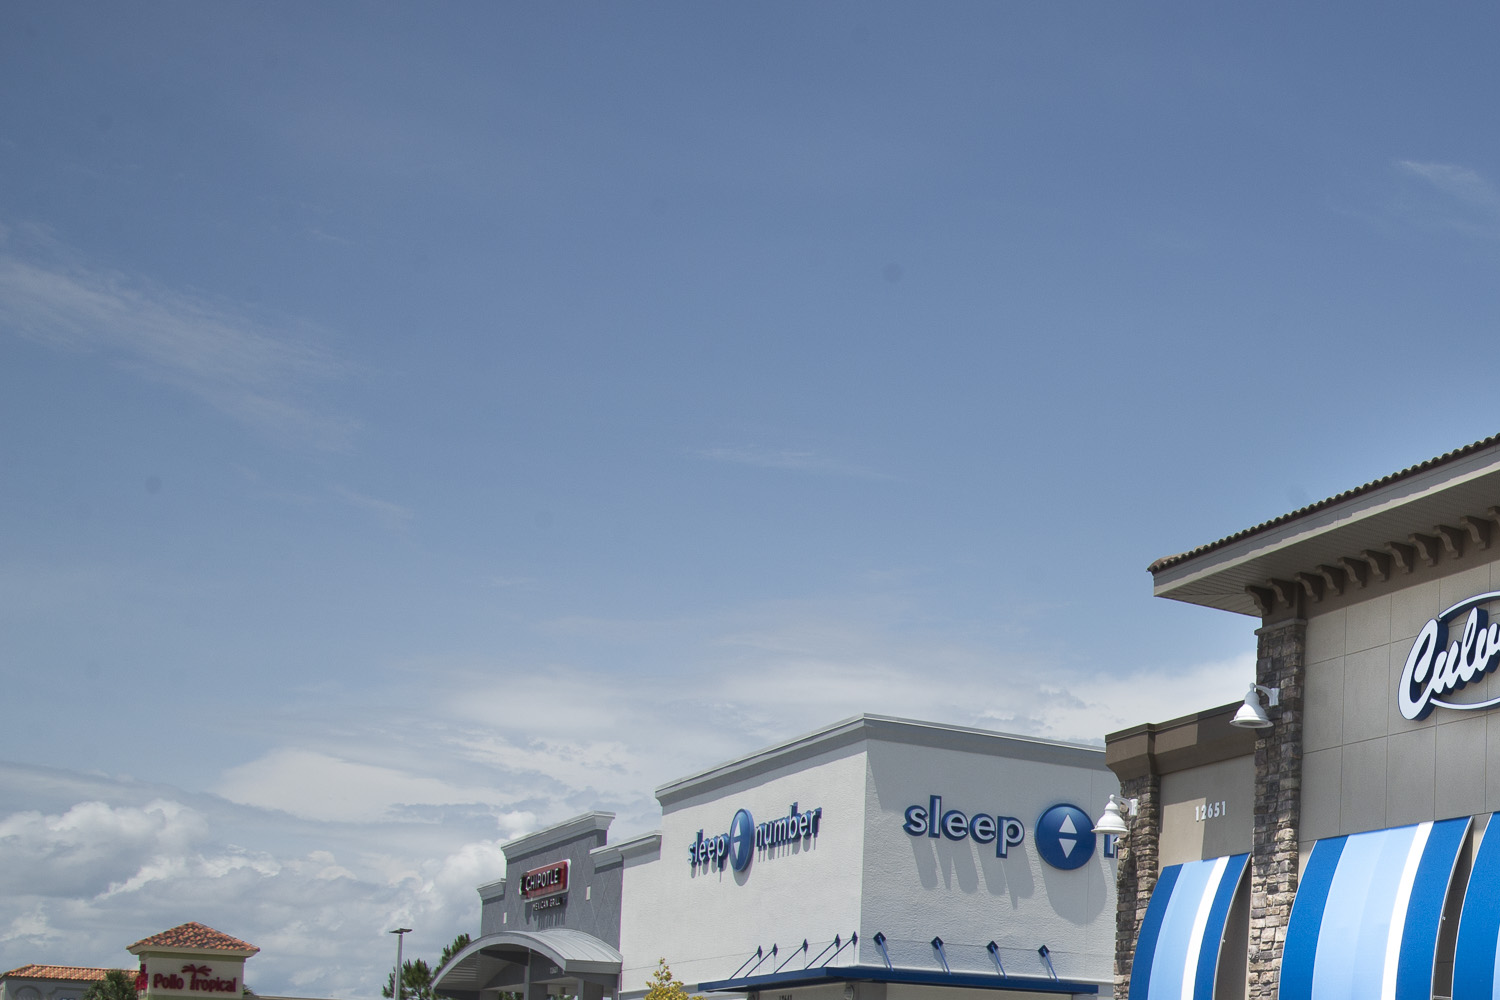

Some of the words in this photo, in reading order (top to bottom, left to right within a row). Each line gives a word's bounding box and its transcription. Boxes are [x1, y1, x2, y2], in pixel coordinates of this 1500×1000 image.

[1195, 801, 1226, 821] 12651
[688, 829, 729, 868] sleep
[755, 802, 822, 849] number
[903, 795, 1025, 858] sleep
[525, 868, 559, 891] CHIPOTLE
[153, 973, 184, 989] Pollo
[184, 966, 237, 992] Tropical
